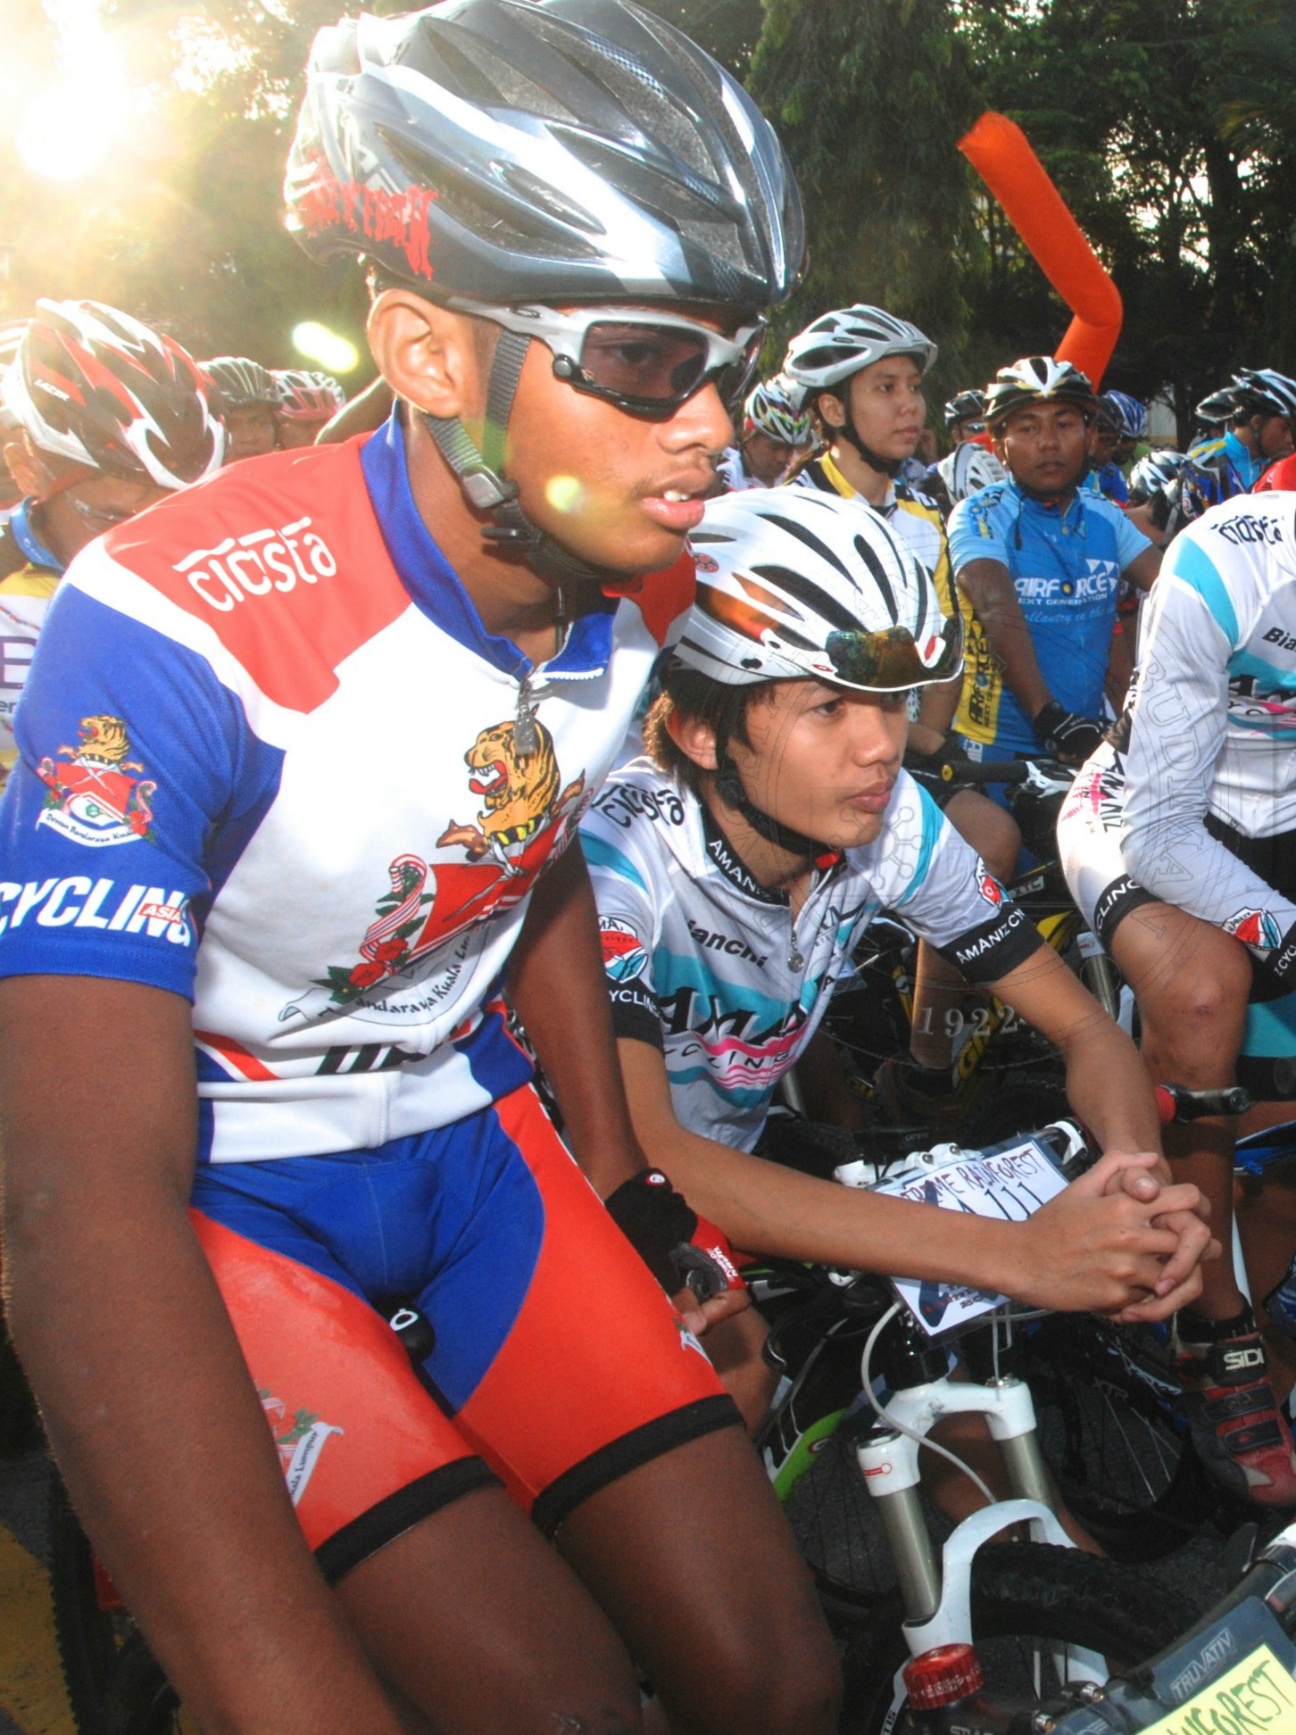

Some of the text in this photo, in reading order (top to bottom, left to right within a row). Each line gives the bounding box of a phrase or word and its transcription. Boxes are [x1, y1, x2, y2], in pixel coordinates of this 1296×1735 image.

[687, 919, 769, 969] ianchi
[956, 923, 1011, 964] AMANIZ
[354, 994, 438, 1017] andaraya
[1170, 1626, 1236, 1701] TRUVATIV
